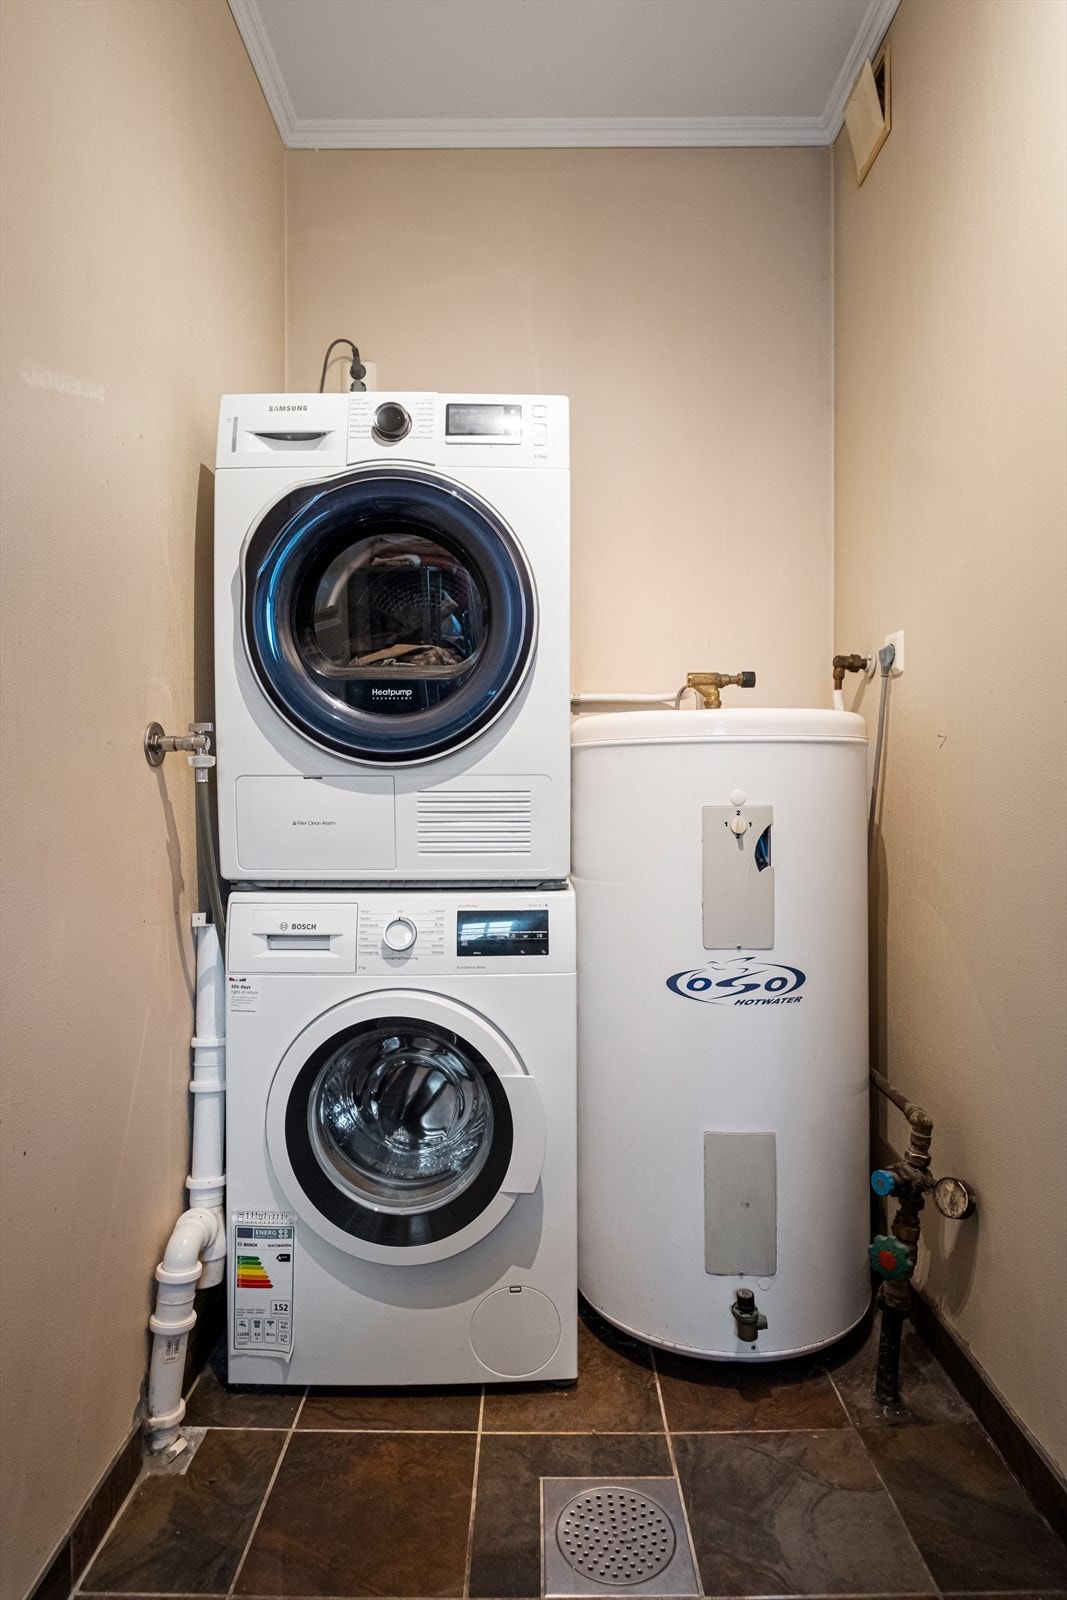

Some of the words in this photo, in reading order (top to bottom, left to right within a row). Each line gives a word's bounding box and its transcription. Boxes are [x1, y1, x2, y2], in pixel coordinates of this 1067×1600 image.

[372, 688, 413, 697] Heatpump
[734, 996, 803, 1006] HOTWATER
[274, 1303, 289, 1312] 152
